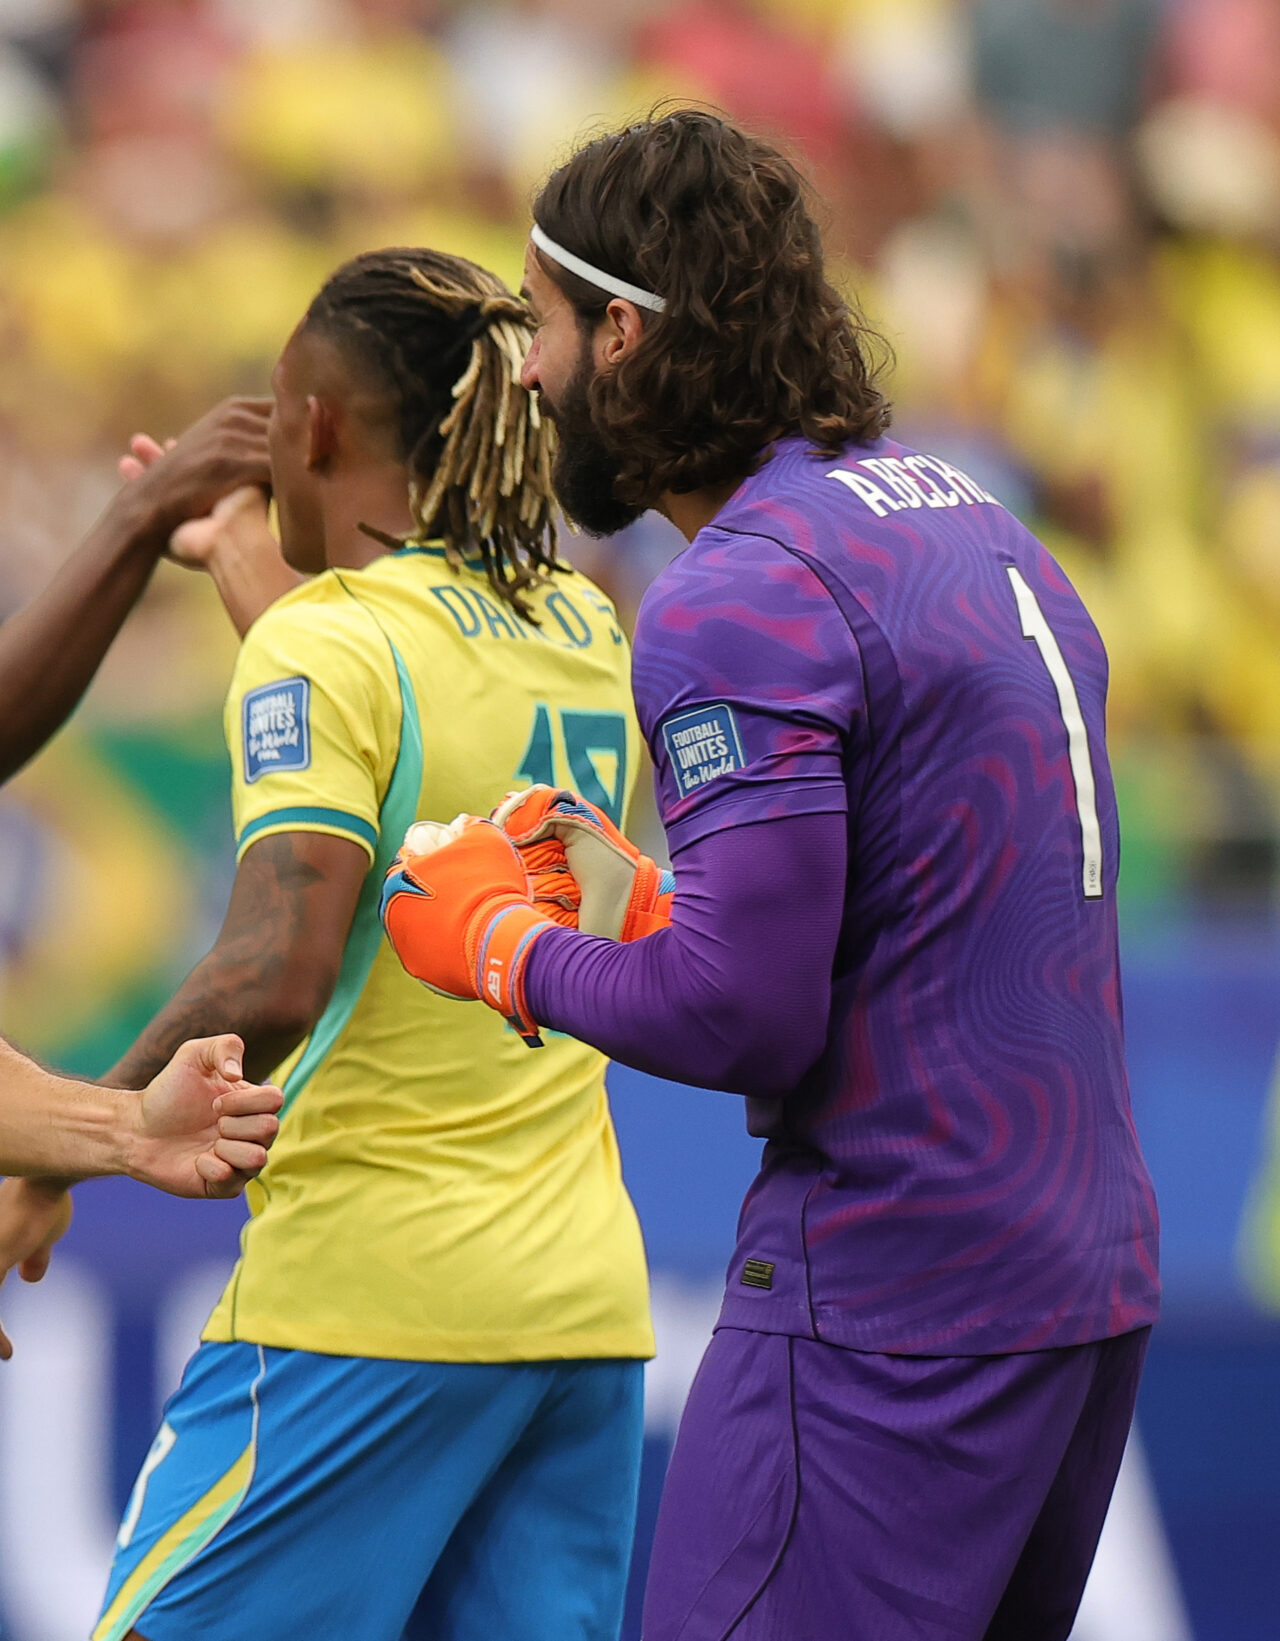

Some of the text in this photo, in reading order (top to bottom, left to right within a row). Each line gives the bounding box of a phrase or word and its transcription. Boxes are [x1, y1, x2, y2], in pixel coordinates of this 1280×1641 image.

[824, 454, 1004, 518] A.BECK
[249, 710, 295, 738] UNITES
[672, 719, 724, 749] FOOTBALL
[1006, 565, 1103, 899] 1
[676, 735, 729, 769] UNITES
[682, 755, 735, 789] the World
